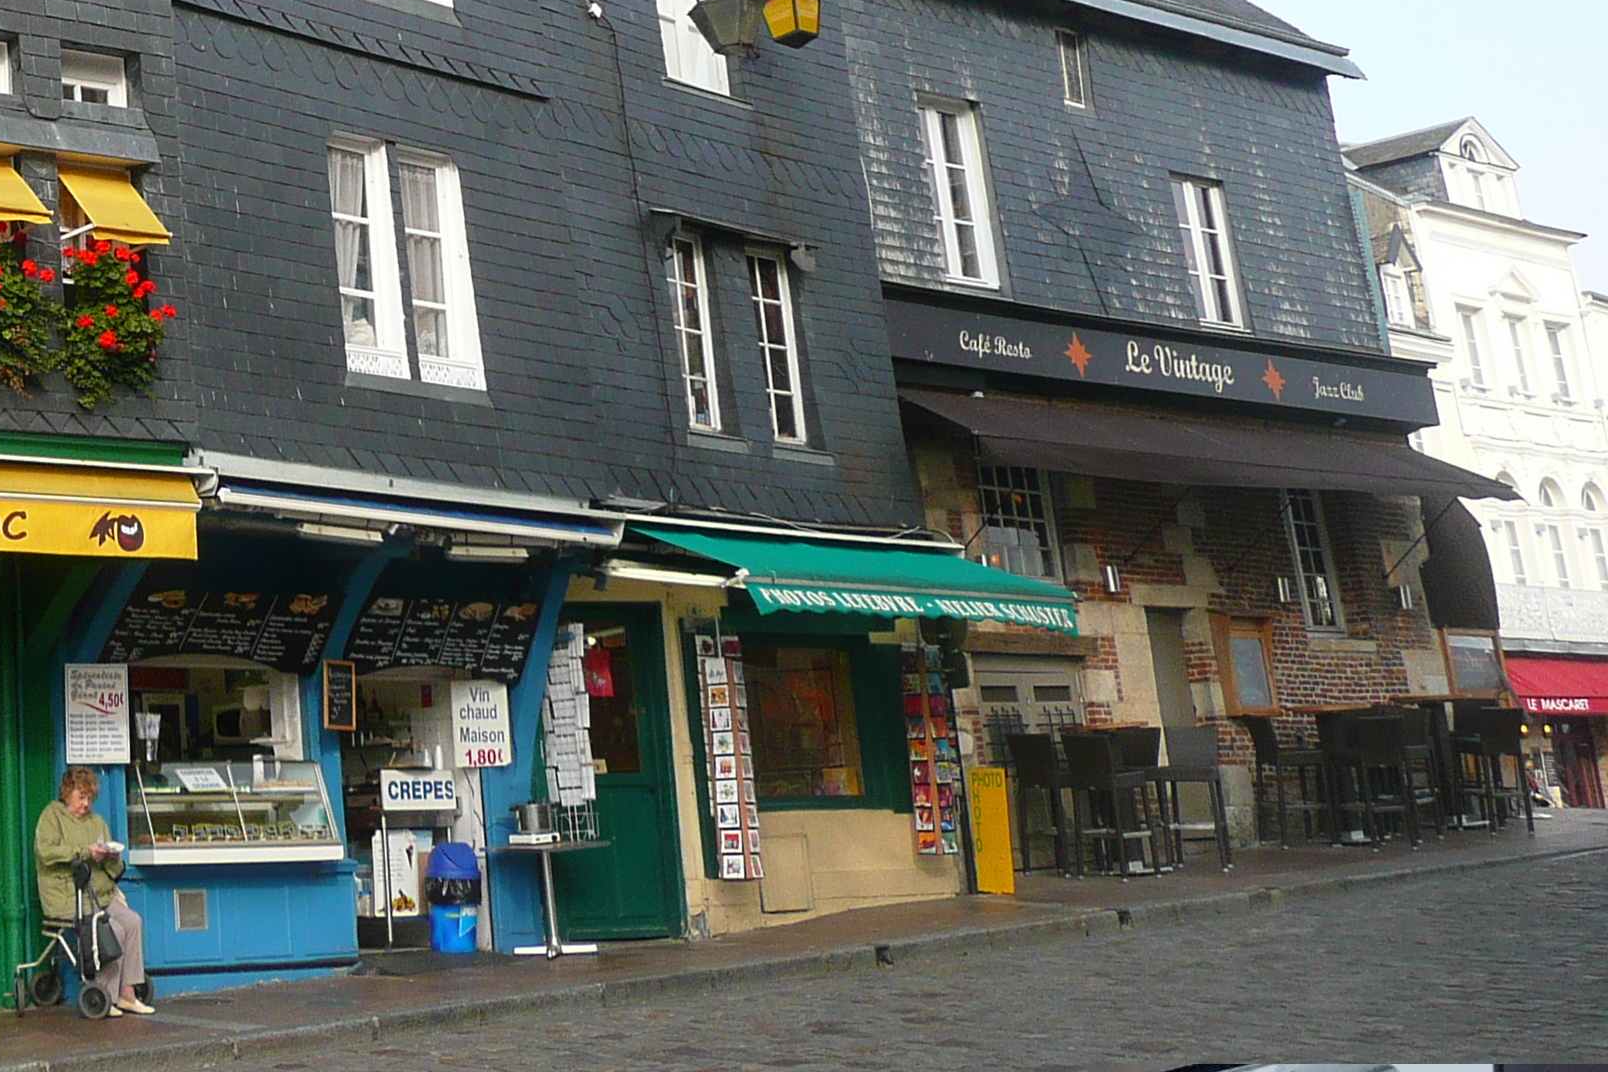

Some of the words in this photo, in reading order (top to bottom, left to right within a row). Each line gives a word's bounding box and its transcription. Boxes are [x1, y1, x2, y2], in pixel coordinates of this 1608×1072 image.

[959, 330, 991, 358] Café
[994, 337, 1032, 359] Resto
[1125, 340, 1152, 373] Le
[1153, 341, 1234, 393] Vintage
[1312, 376, 1338, 399] Jazz
[1339, 379, 1364, 402] Club
[758, 587, 837, 608] PHOTOS
[469, 686, 490, 703] Vin
[459, 704, 498, 720] chaud
[1526, 698, 1538, 710] LE
[1541, 698, 1590, 711] MASCARET
[459, 726, 505, 743] Maison
[971, 772, 1003, 788] PHOTO
